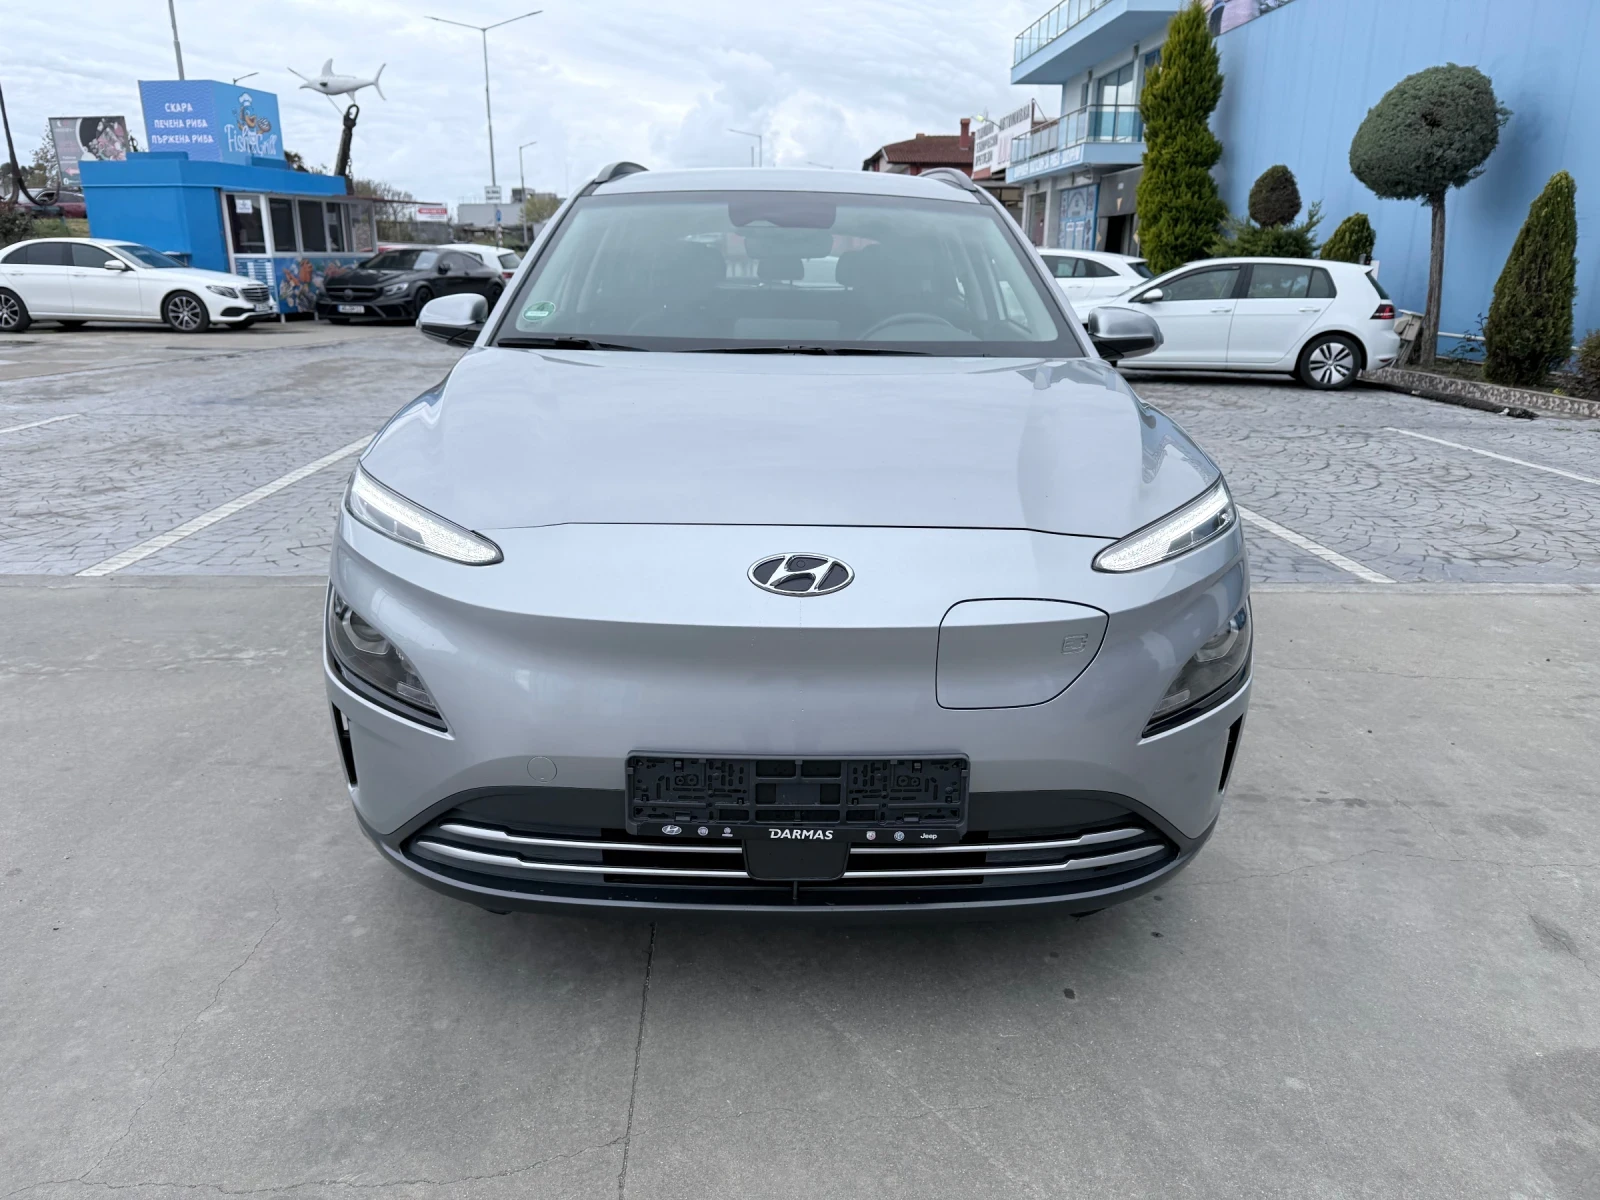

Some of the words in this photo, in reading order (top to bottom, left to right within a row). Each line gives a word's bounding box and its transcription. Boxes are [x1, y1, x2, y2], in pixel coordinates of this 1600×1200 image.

[165, 102, 194, 113] СКАРА
[154, 119, 184, 128] ПЕЧЕНА
[186, 118, 208, 128] РИБА
[151, 134, 190, 144] ПЪРЖЕНА
[192, 134, 214, 144] РИБА
[768, 828, 834, 840] DARMAS
[920, 832, 938, 840] Jeep
